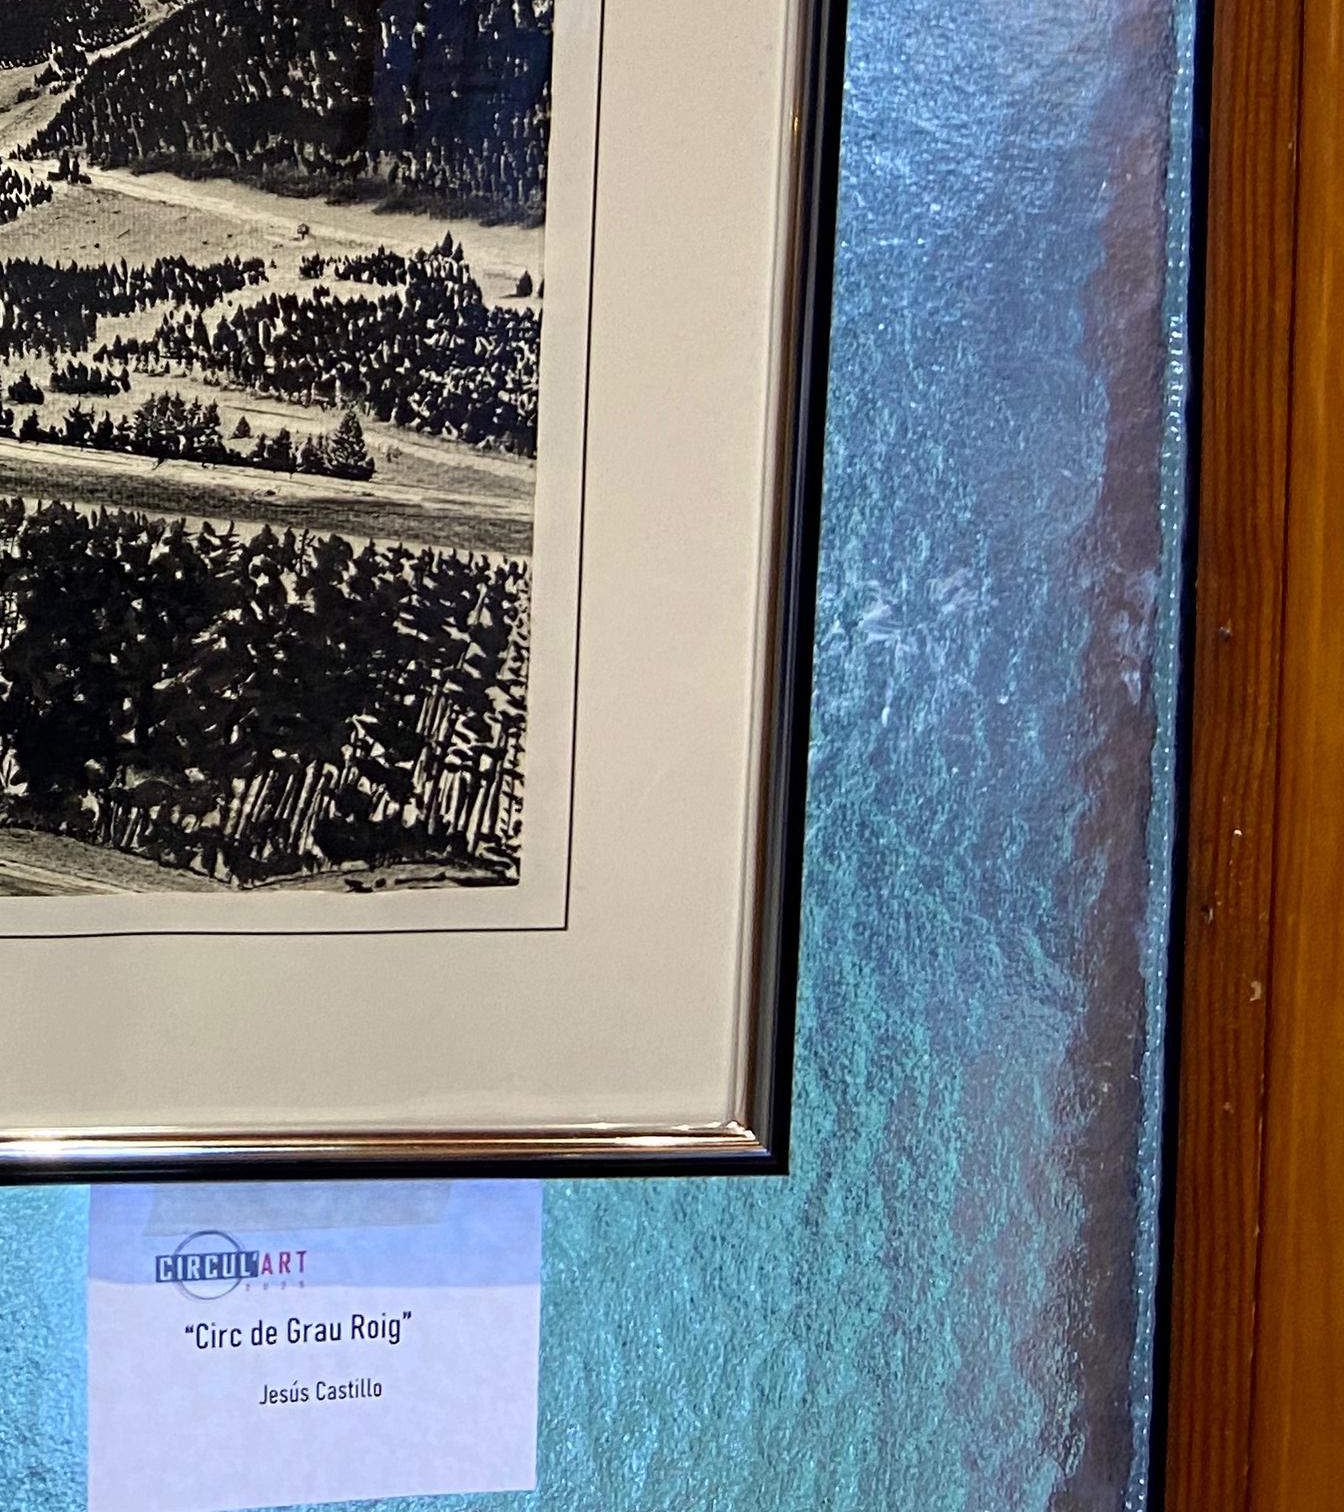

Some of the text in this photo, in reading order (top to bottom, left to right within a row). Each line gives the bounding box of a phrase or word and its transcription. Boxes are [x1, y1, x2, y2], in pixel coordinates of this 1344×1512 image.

[184, 1311, 413, 1350] “Circ de Grau Roig”
[258, 1378, 383, 1405] Jesús Castillo
